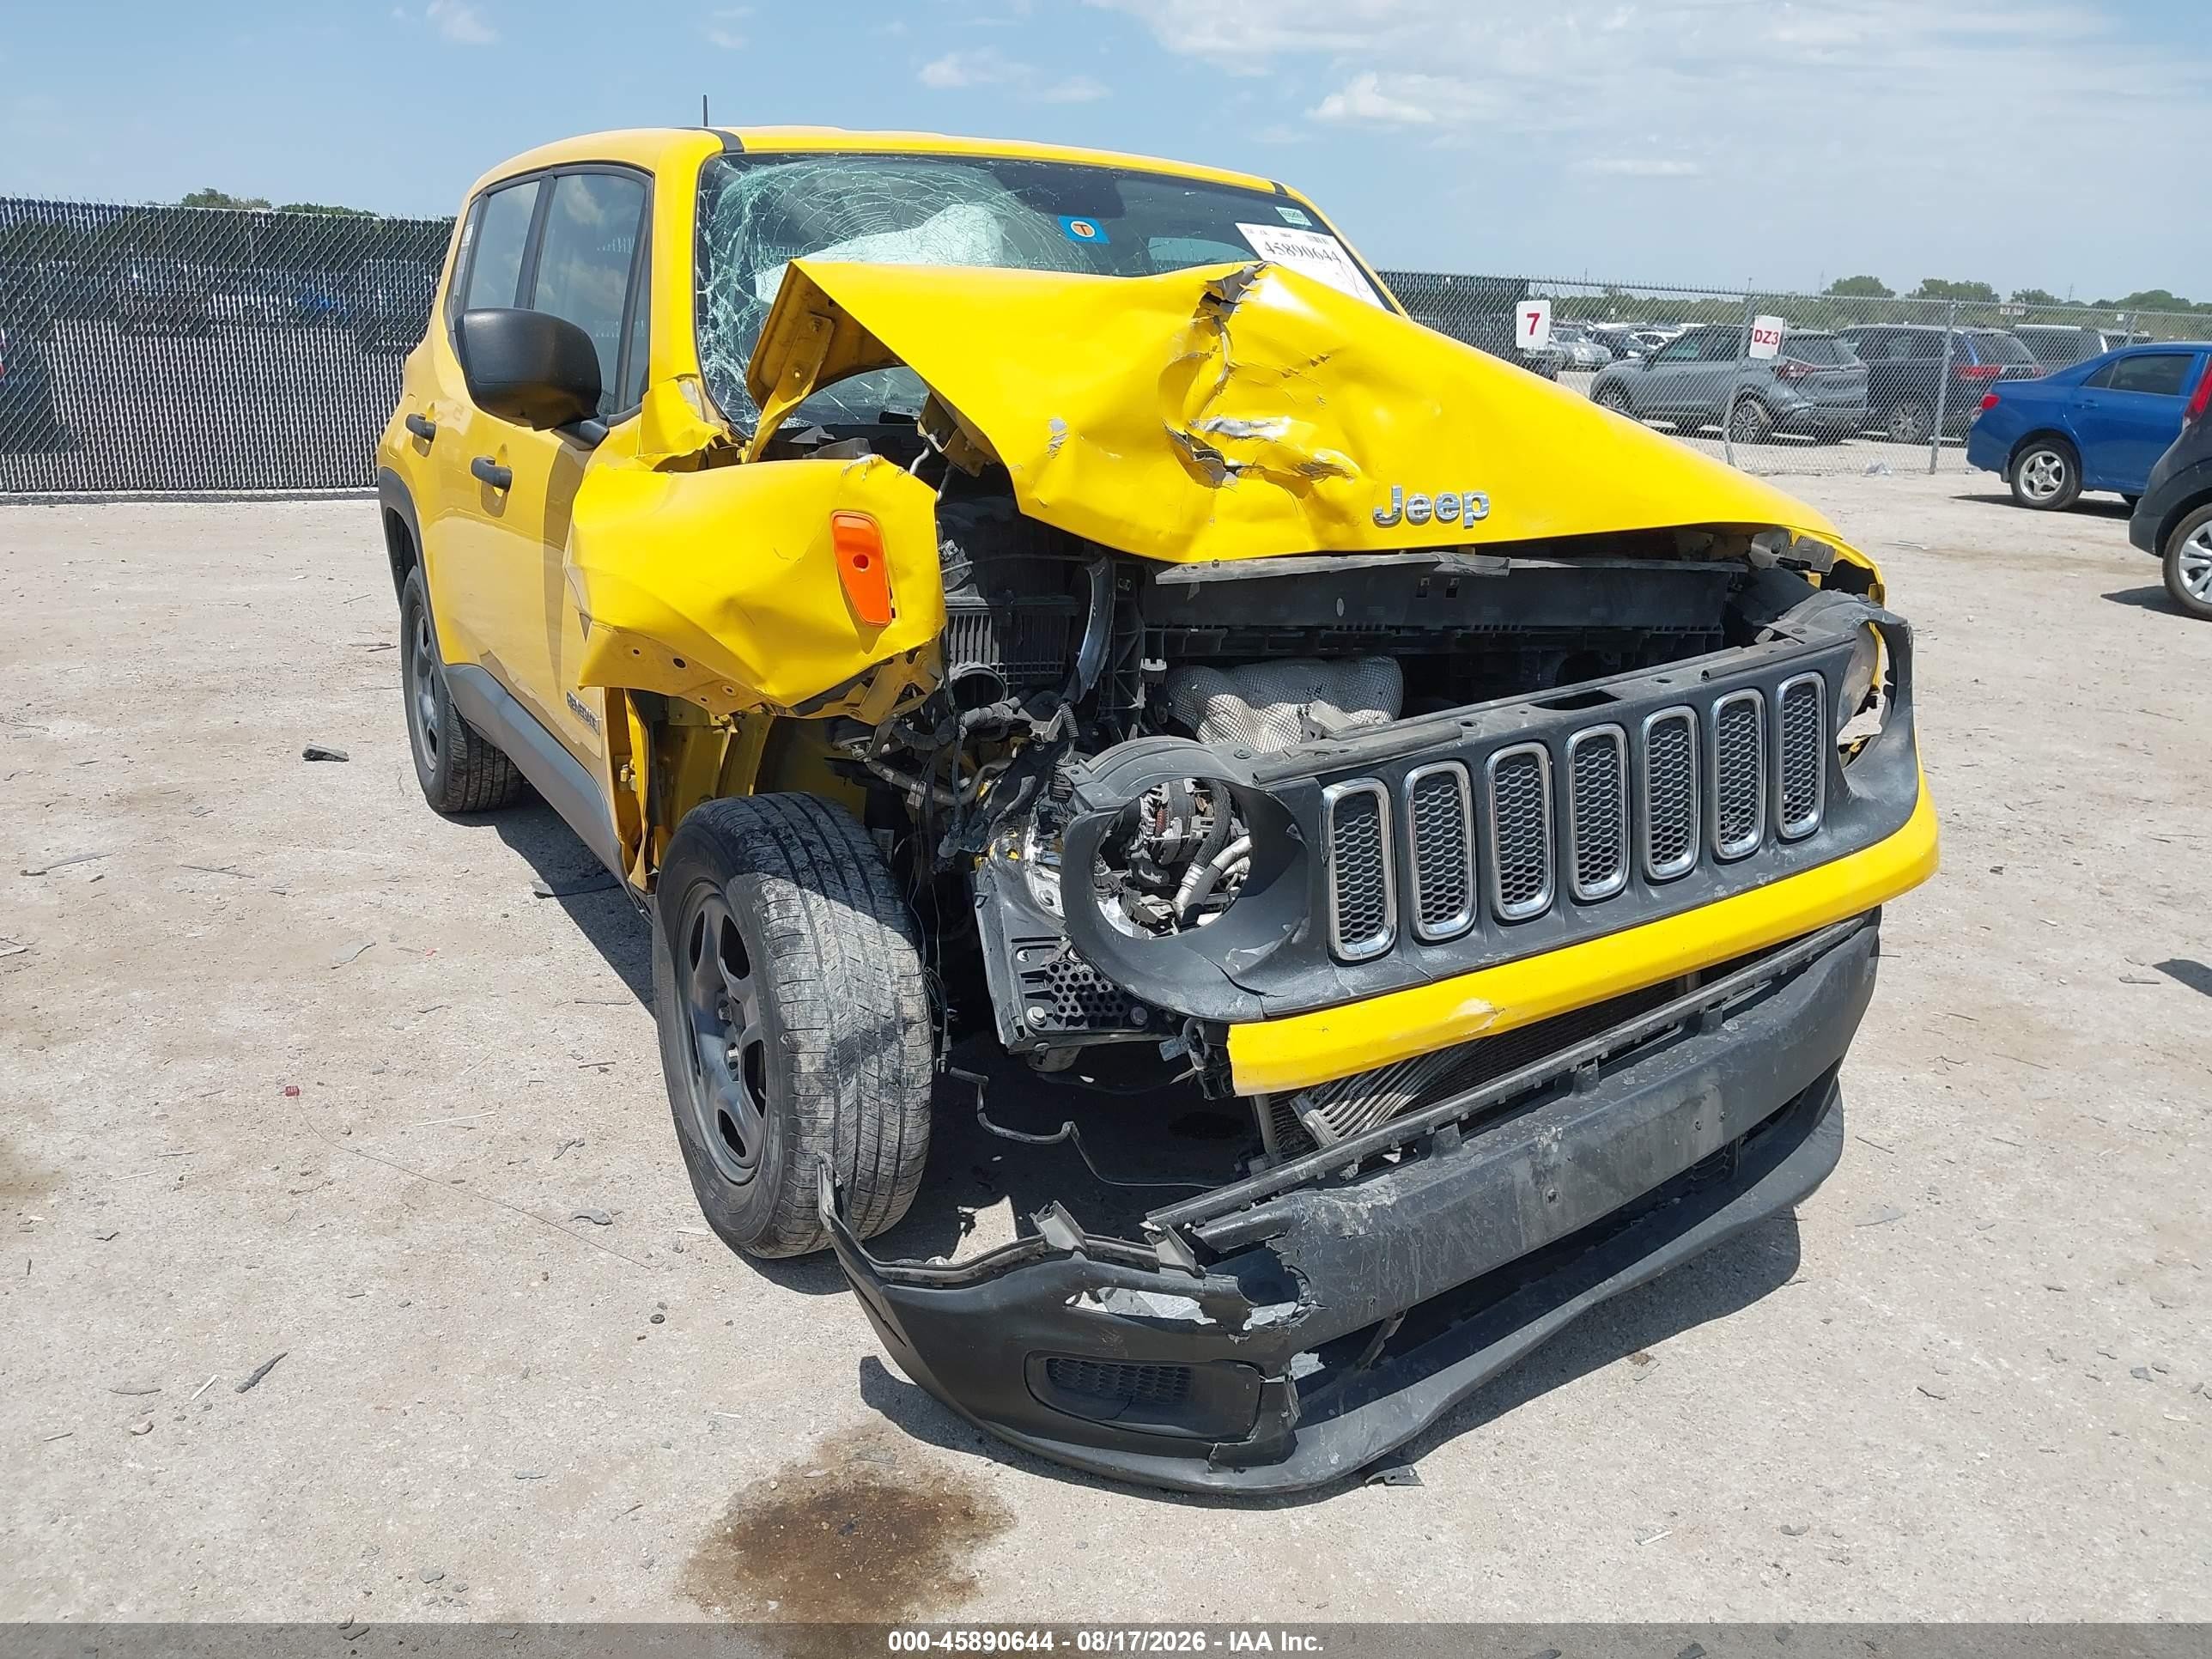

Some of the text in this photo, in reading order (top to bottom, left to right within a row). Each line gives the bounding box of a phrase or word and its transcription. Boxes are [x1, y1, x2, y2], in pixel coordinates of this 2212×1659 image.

[1265, 240, 1341, 264] 45890644
[1526, 313, 1540, 336] 7
[1753, 329, 1779, 345] DZ3
[1373, 485, 1490, 529] Jeep
